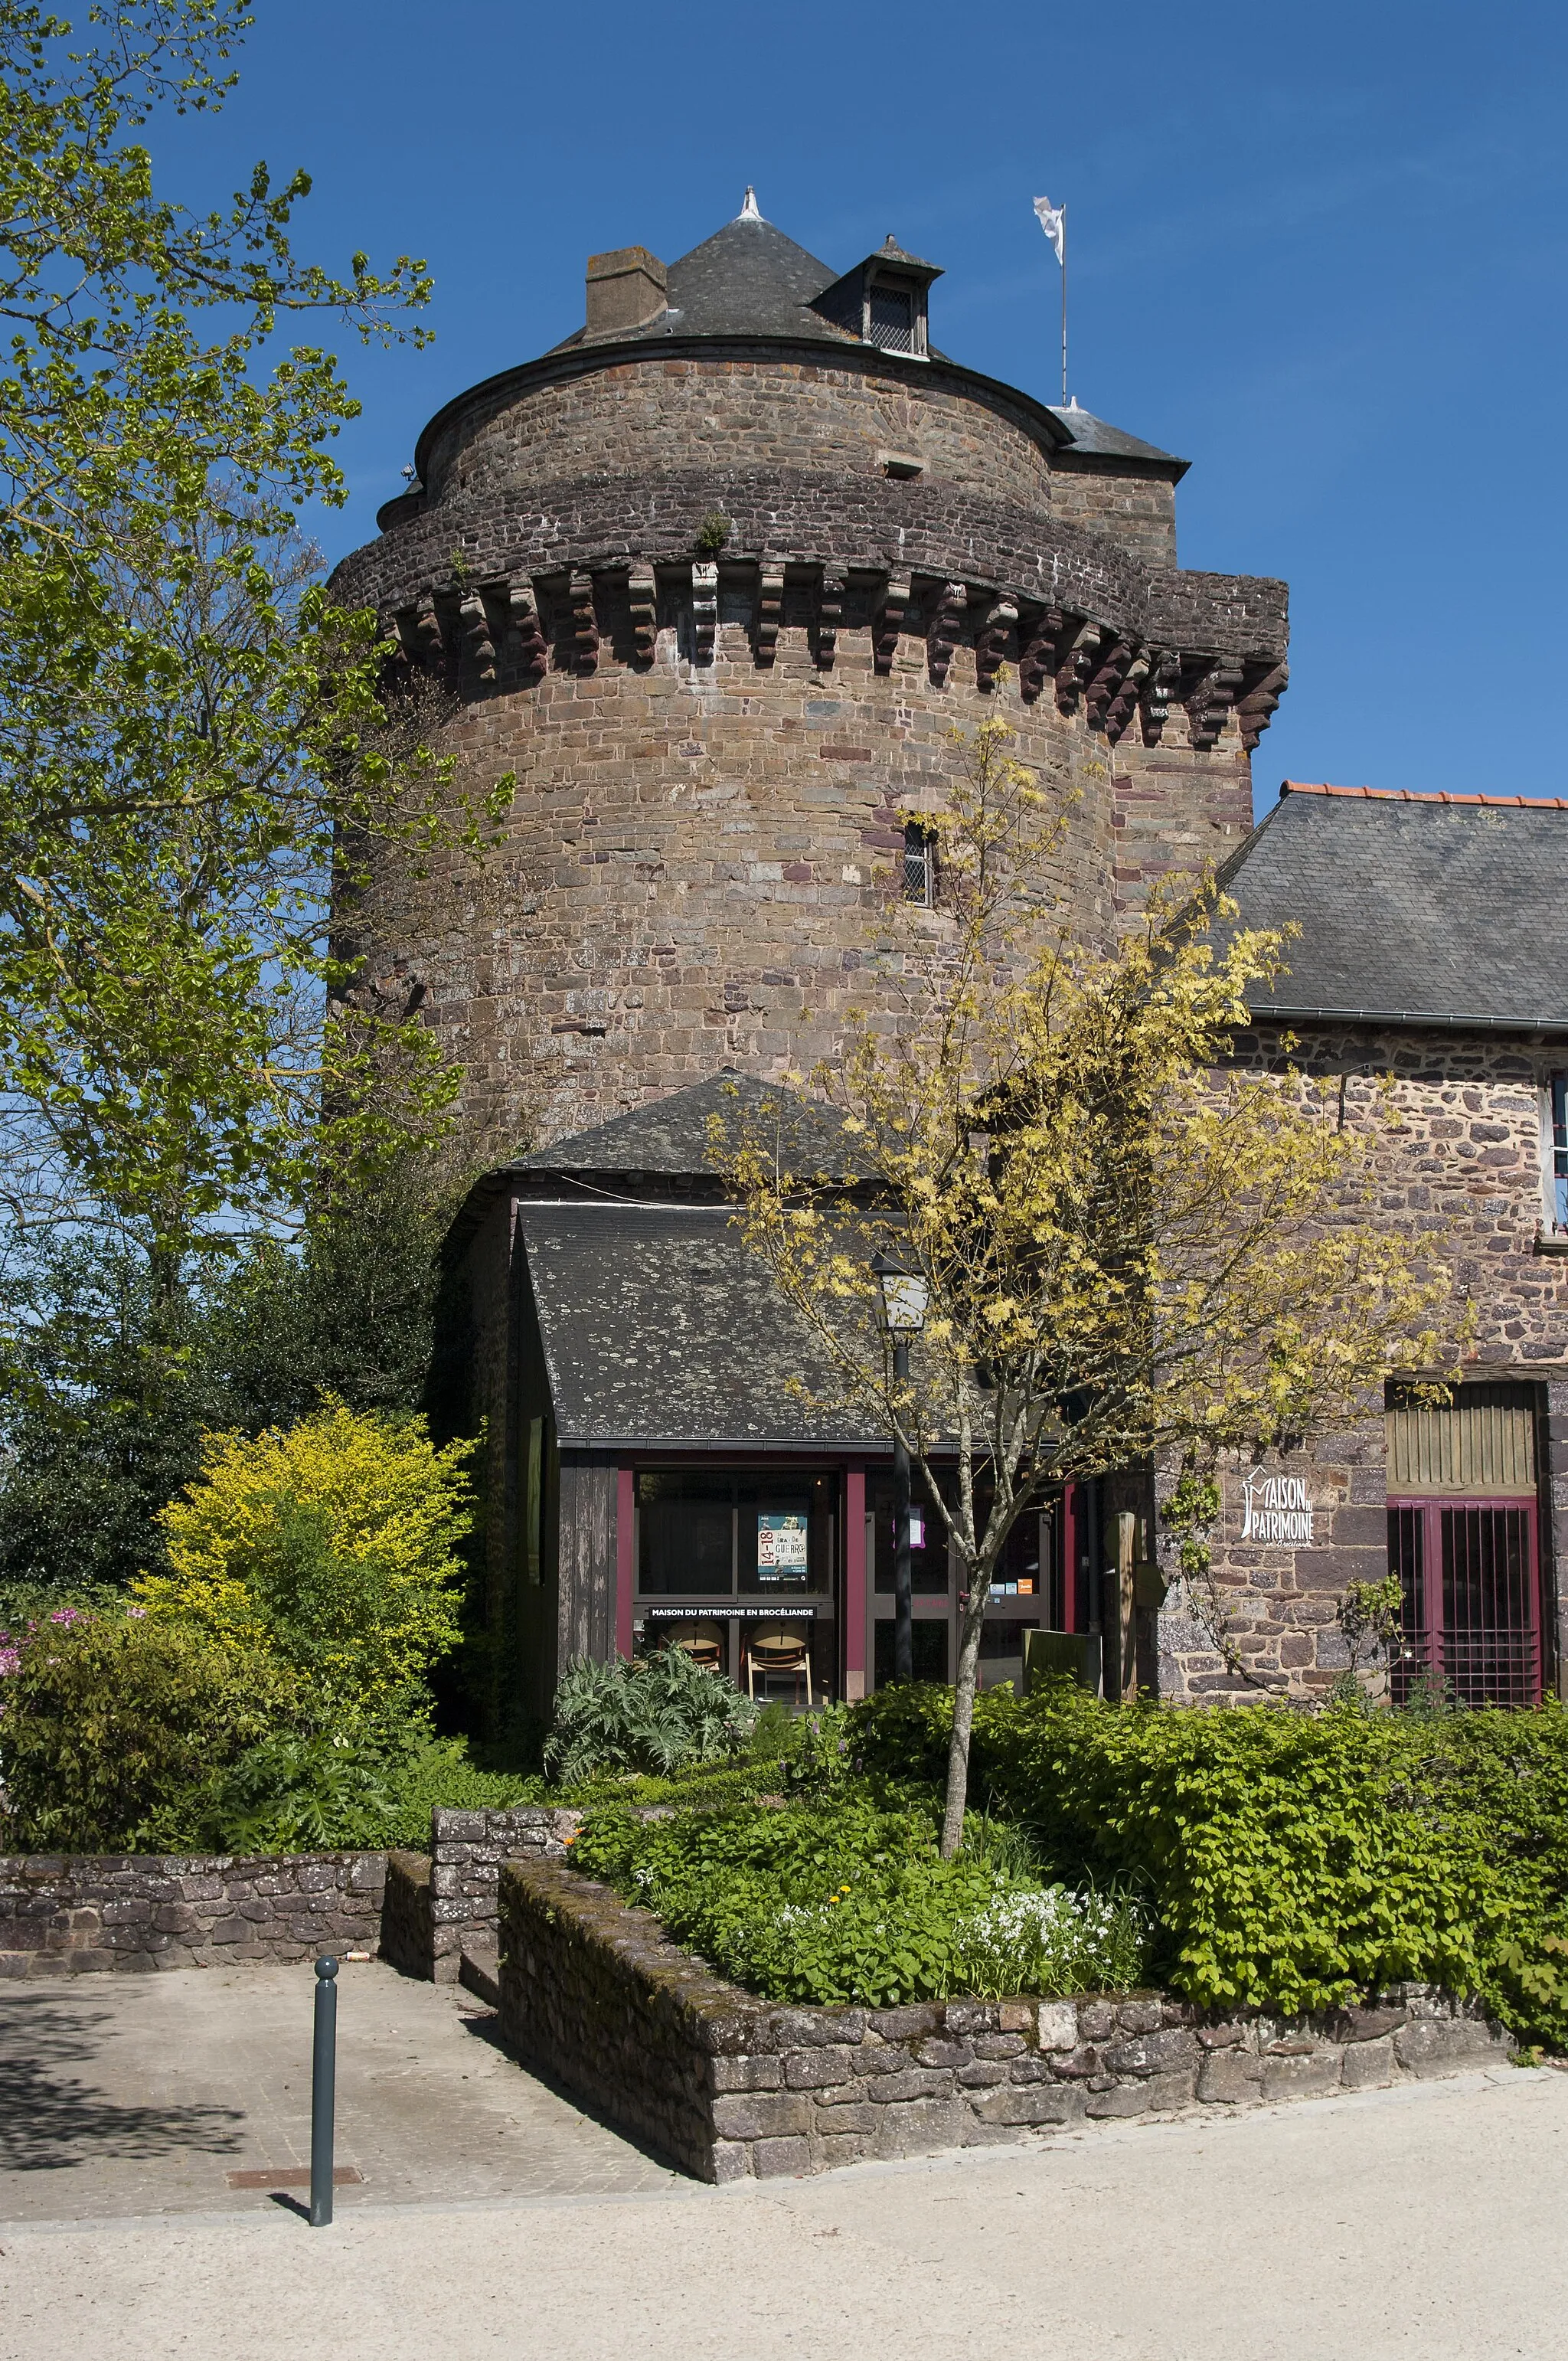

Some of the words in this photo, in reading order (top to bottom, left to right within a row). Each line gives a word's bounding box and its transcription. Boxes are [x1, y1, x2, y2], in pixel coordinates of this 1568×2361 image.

[1242, 1477, 1306, 1511] MAISON
[1306, 1499, 1313, 1512] DU
[1252, 1512, 1314, 1540] PATRIMOINE
[760, 1532, 775, 1565] 14-18
[759, 1607, 814, 1616] BROCÉLIANDE
